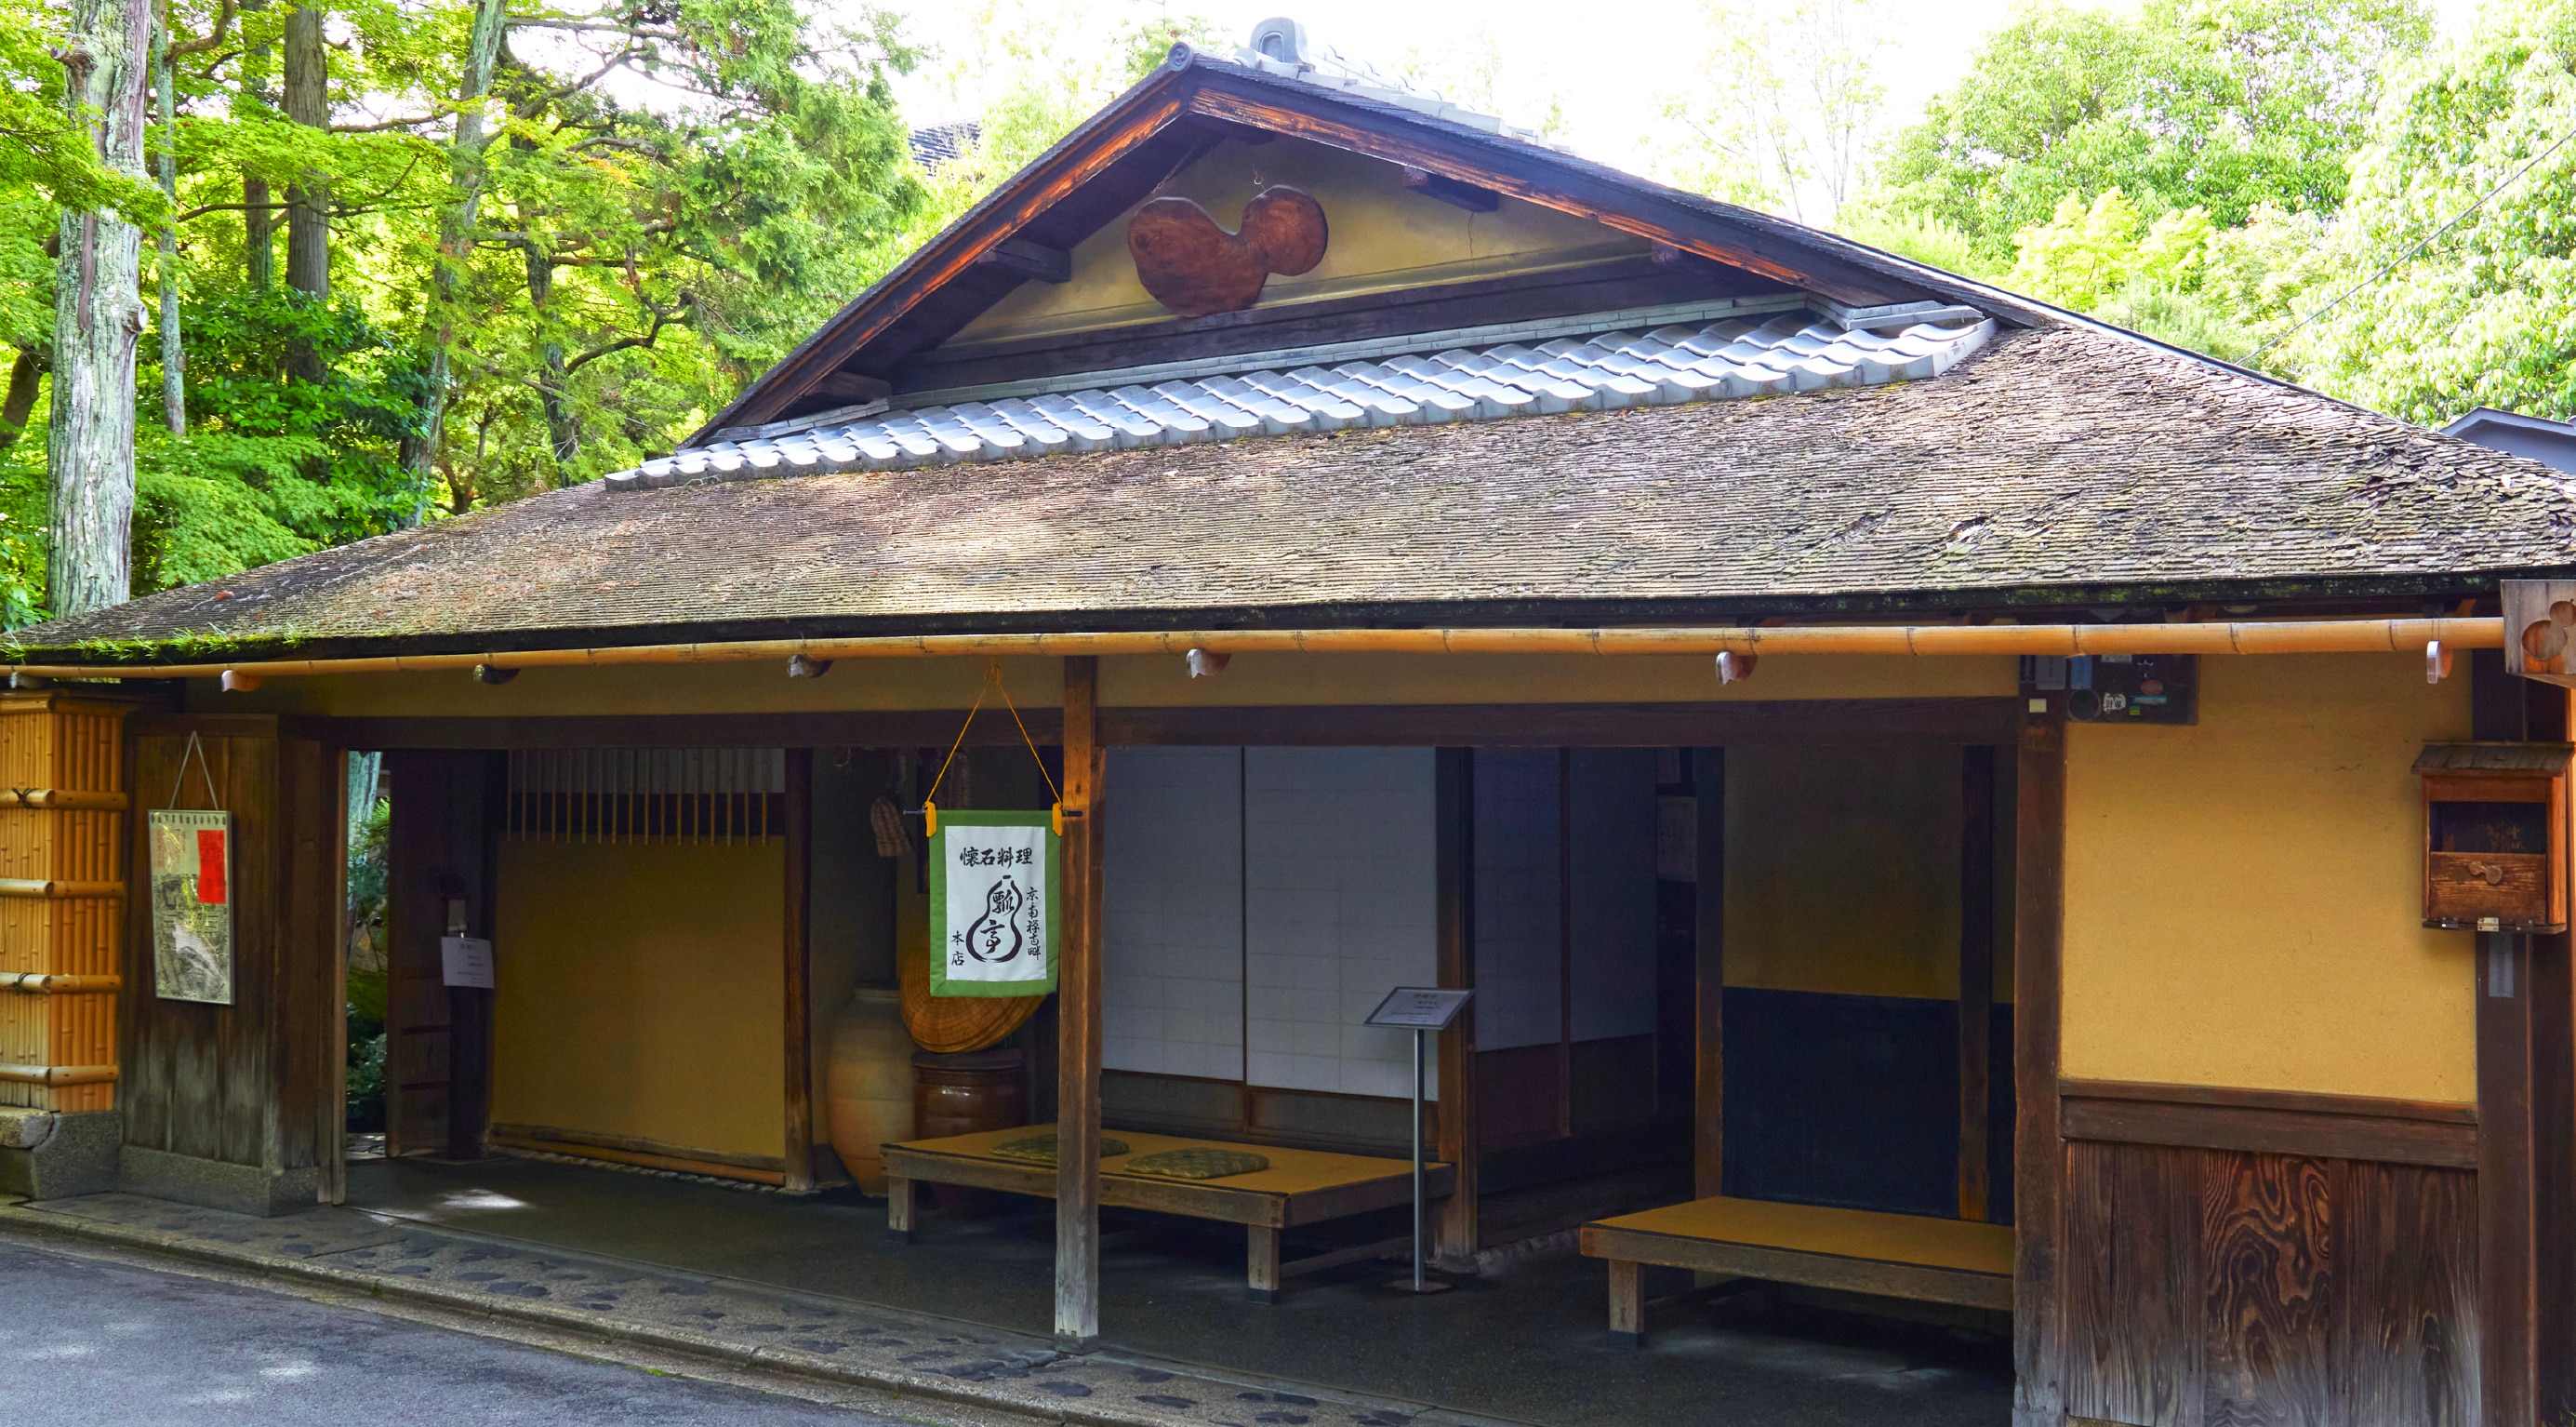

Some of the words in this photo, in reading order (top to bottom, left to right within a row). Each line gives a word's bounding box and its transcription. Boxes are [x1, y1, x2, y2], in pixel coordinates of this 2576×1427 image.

[960, 847, 1033, 869] 懐石料理
[951, 930, 965, 967] 本店
